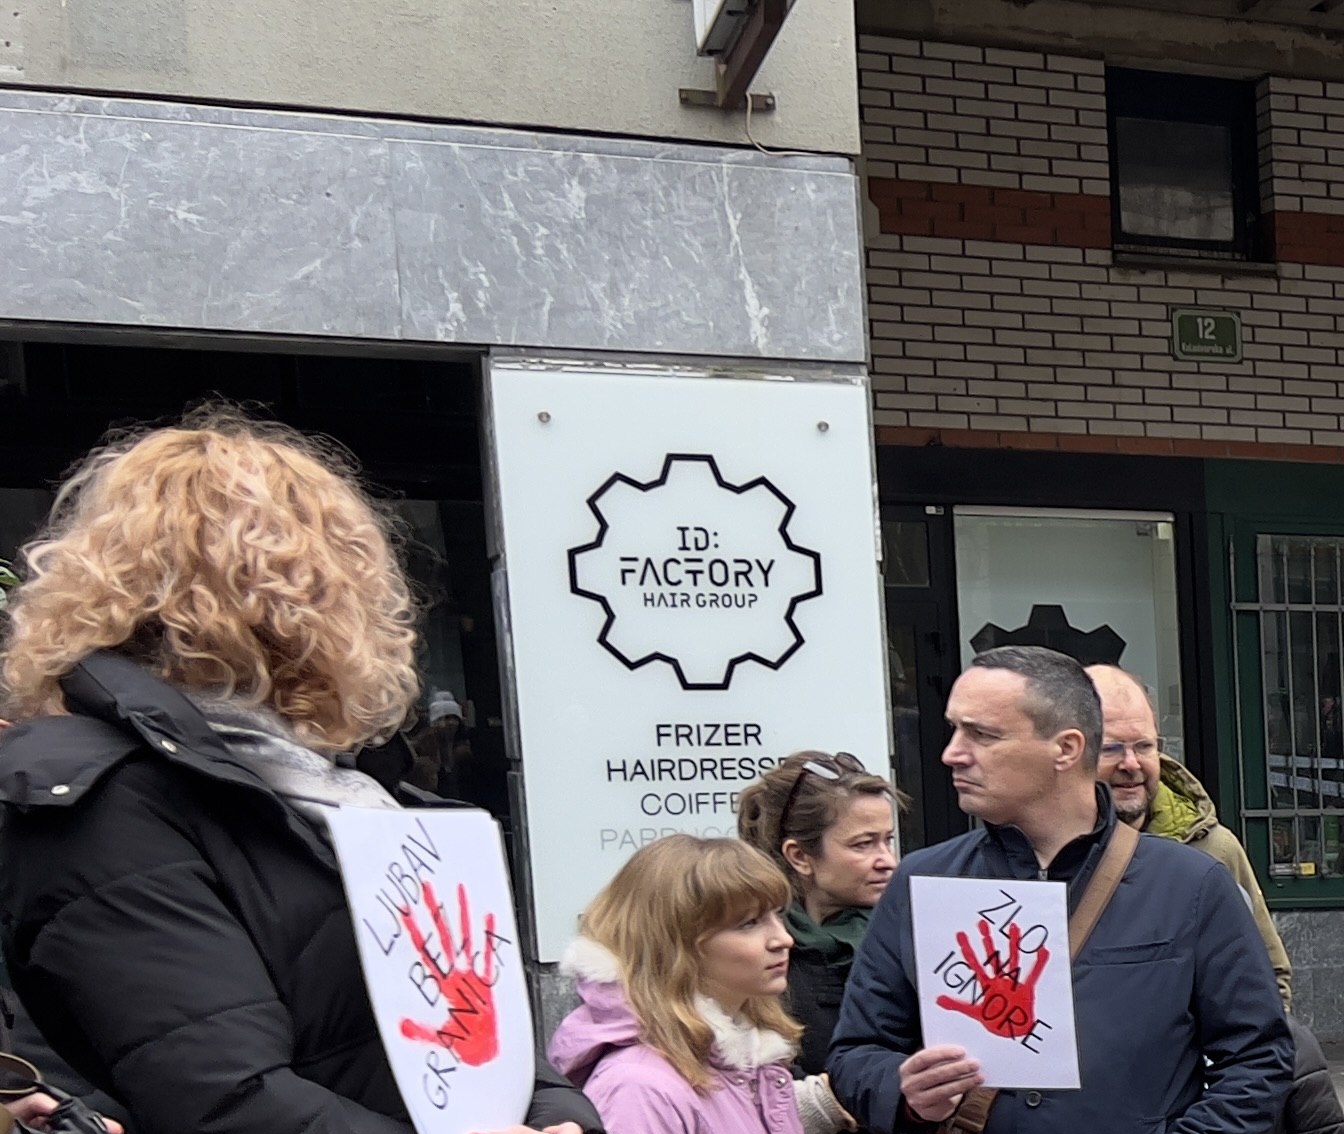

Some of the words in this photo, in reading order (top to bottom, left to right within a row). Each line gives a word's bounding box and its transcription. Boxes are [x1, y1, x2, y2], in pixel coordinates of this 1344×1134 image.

[1196, 317, 1216, 340] 12
[676, 526, 719, 551] ID:
[619, 557, 775, 587] FACTORY
[643, 593, 691, 608] HAIR
[696, 593, 758, 608] GROUP
[655, 723, 763, 747] FRIZER
[606, 756, 789, 782] HAIRDRESS
[362, 817, 442, 956] LJUBAV
[977, 889, 1049, 954] ZLO
[933, 951, 1053, 1055] IGNORE
[423, 930, 512, 1110] GRANICA
